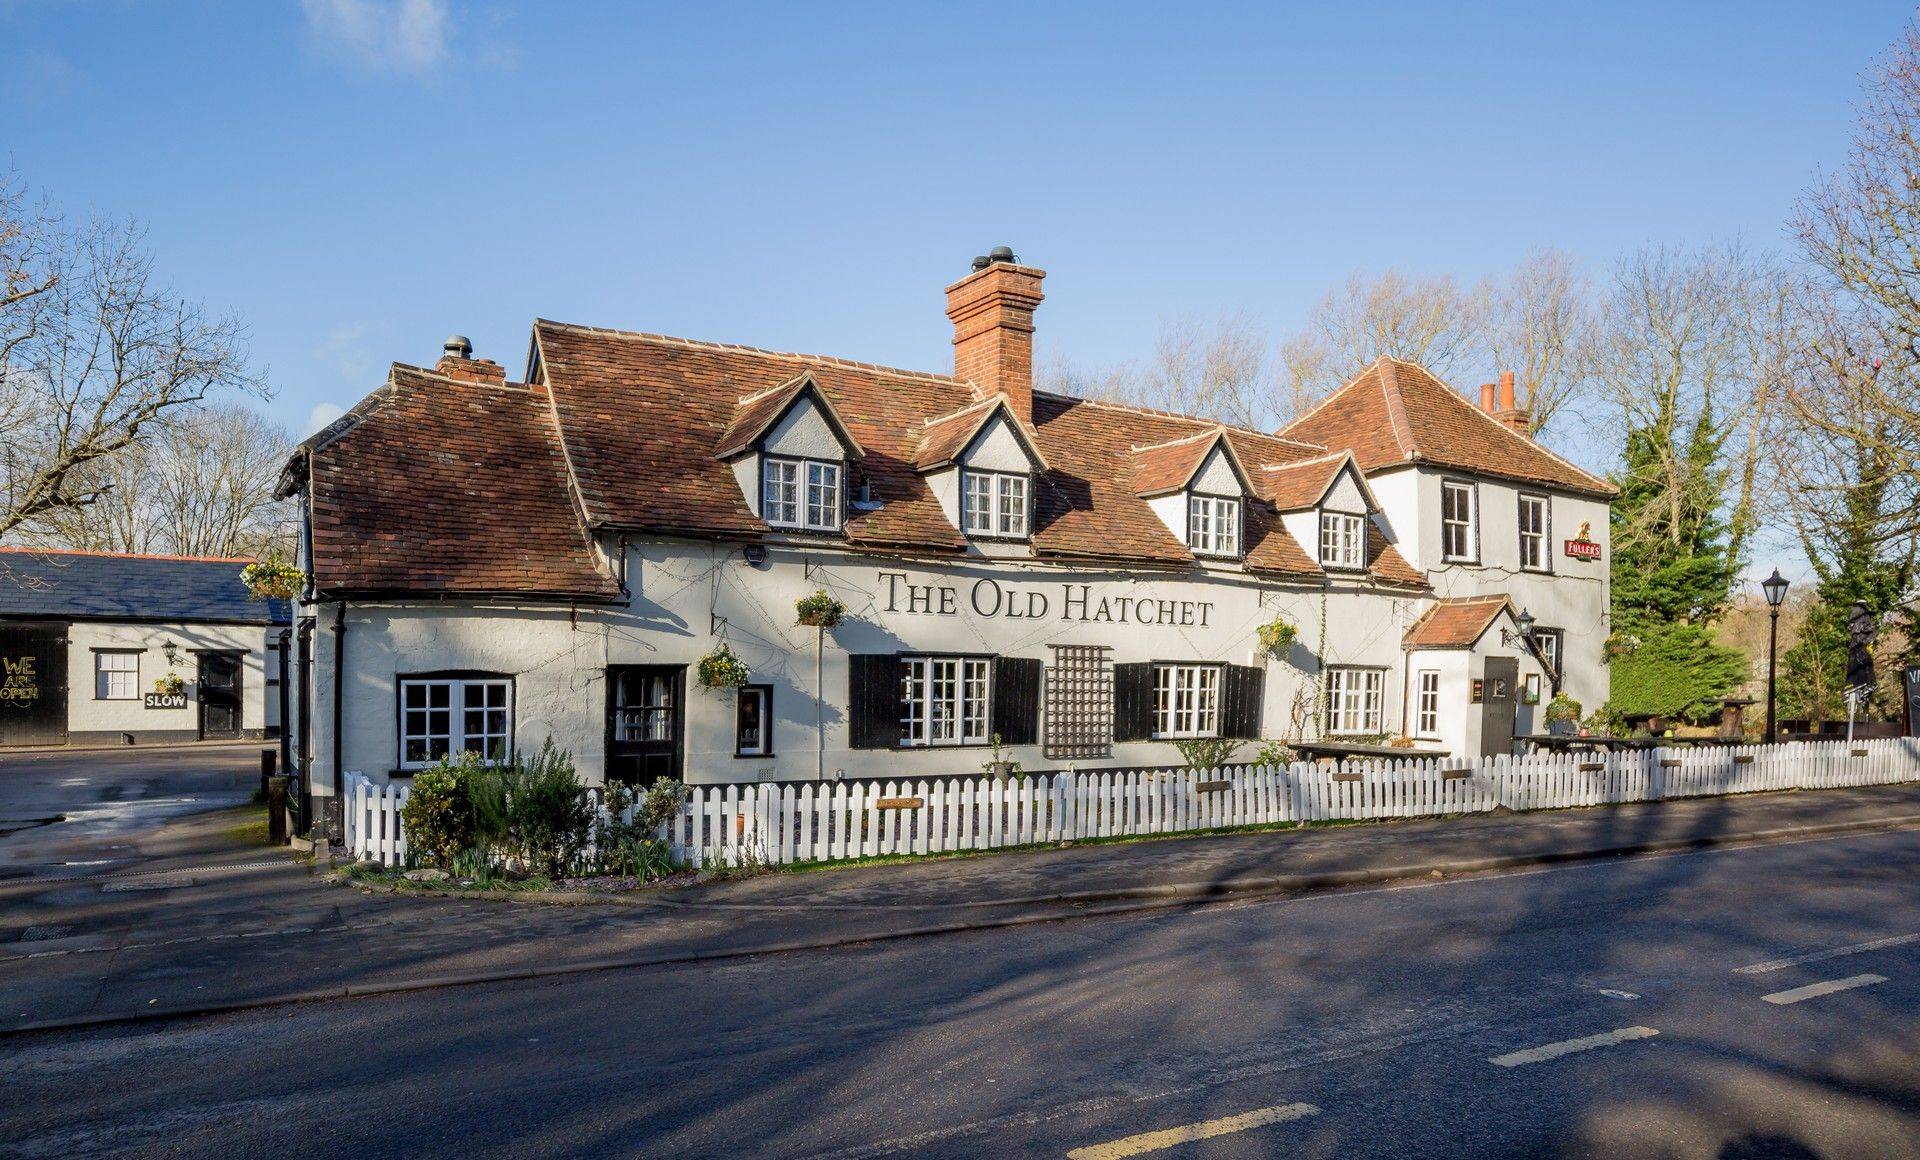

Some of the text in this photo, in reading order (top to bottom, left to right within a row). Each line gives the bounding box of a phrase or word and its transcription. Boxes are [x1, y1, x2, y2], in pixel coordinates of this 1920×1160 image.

[1568, 541, 1600, 555] FULLER'S
[878, 571, 1214, 626] THE OLD HATCHET
[3, 656, 36, 675] WE
[4, 675, 36, 688] ARE
[0, 687, 39, 700] OPEN
[146, 695, 186, 707] SLOW
